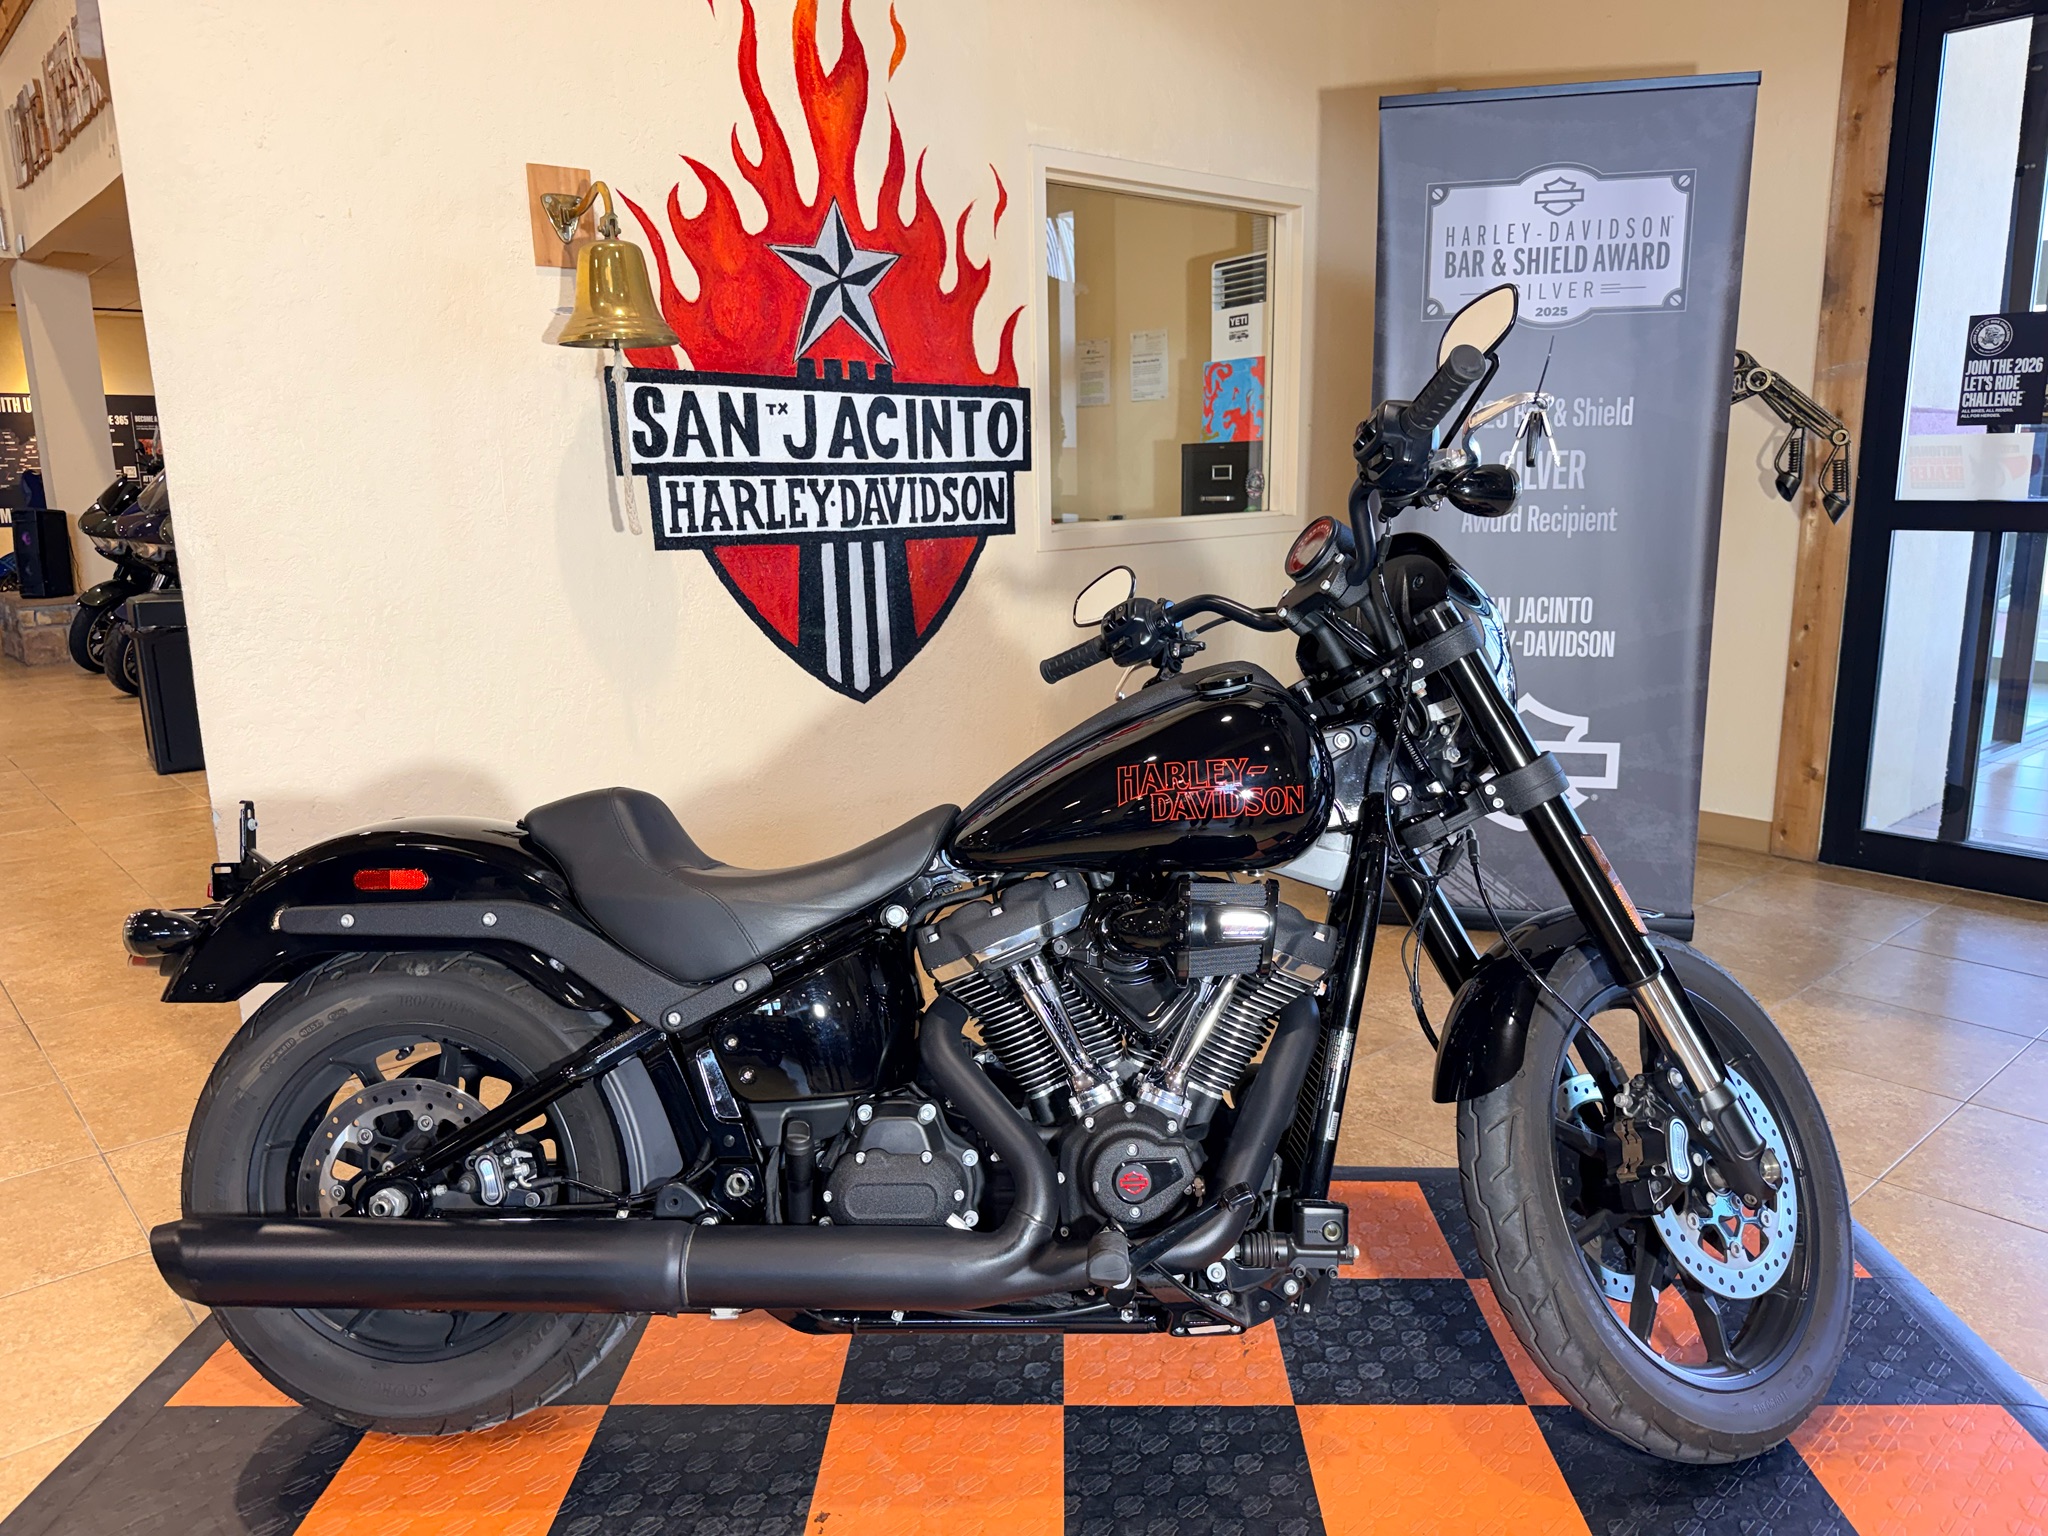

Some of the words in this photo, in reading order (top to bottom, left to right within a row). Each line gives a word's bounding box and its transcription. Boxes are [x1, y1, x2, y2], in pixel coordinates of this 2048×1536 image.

[1446, 216, 1672, 247] HARLEY-DAVIDSON
[1444, 250, 1485, 278] BAR
[1492, 248, 1507, 276] &
[1513, 245, 1588, 276] SHIELD
[1592, 242, 1671, 272] AWARD
[1230, 315, 1248, 327] YETI
[1535, 306, 1568, 317] 2025
[1965, 359, 1992, 375] JOIN
[1992, 358, 2014, 374] THE
[2014, 357, 2044, 373] 2026
[1963, 375, 1994, 391] LET'S
[1994, 375, 2021, 390] RIDE
[0, 396, 21, 413] ITH
[22, 396, 32, 413] U
[1554, 398, 1568, 427] &
[1572, 396, 1635, 426] Shield
[1961, 391, 2024, 407] CHALLENGE
[114, 415, 129, 425] 365
[632, 386, 760, 459] SAN
[766, 402, 788, 416] TX
[783, 394, 1019, 460] JACINTO
[1461, 505, 1522, 533] Award
[1527, 505, 1618, 538] Recipient
[1515, 596, 1593, 624] JACINTO
[1117, 757, 1268, 807] HARLEY-
[1150, 785, 1305, 822] DAVIDSON
